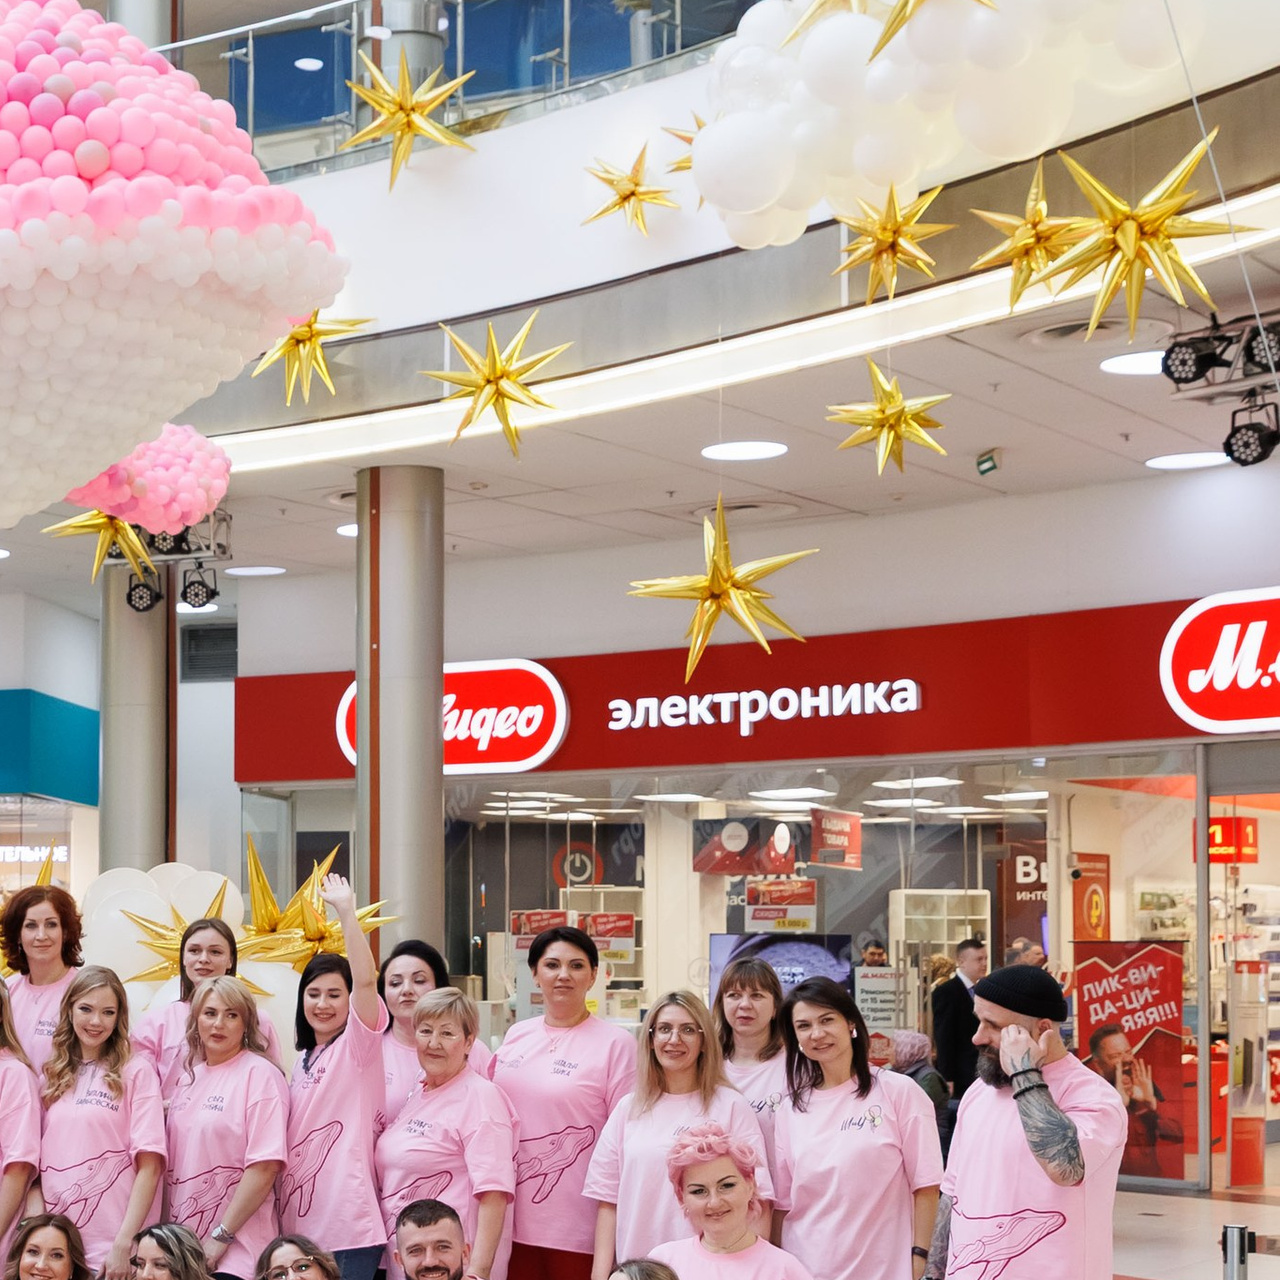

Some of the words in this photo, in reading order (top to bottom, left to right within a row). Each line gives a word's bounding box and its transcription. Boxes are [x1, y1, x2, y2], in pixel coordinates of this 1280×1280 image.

[608, 678, 920, 736] электроника
[1082, 964, 1165, 1002] ЛИК-ВИ-
[1089, 987, 1161, 1025] ДА-ЦИ-
[1121, 1001, 1179, 1033] ЯЯЯ!!!
